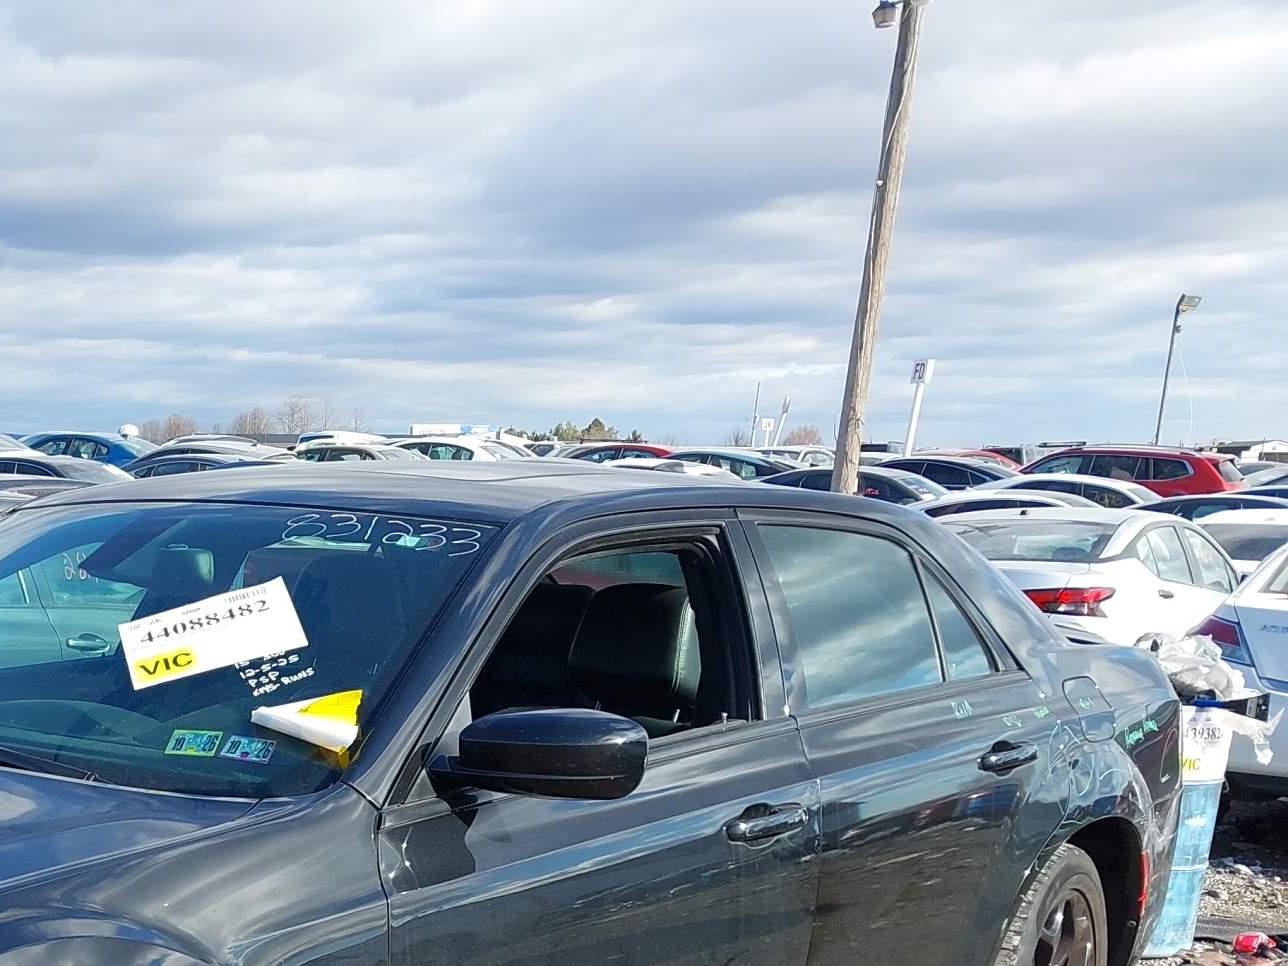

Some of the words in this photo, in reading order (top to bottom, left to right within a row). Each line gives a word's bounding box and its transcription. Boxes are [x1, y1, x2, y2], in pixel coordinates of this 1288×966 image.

[913, 362, 926, 380] FD
[282, 513, 482, 557] 831233
[140, 599, 270, 644] 44088482
[139, 652, 193, 676] VIC
[172, 736, 186, 751] 10
[202, 735, 218, 752] 26
[226, 740, 241, 754] 10
[256, 741, 274, 759] 26
